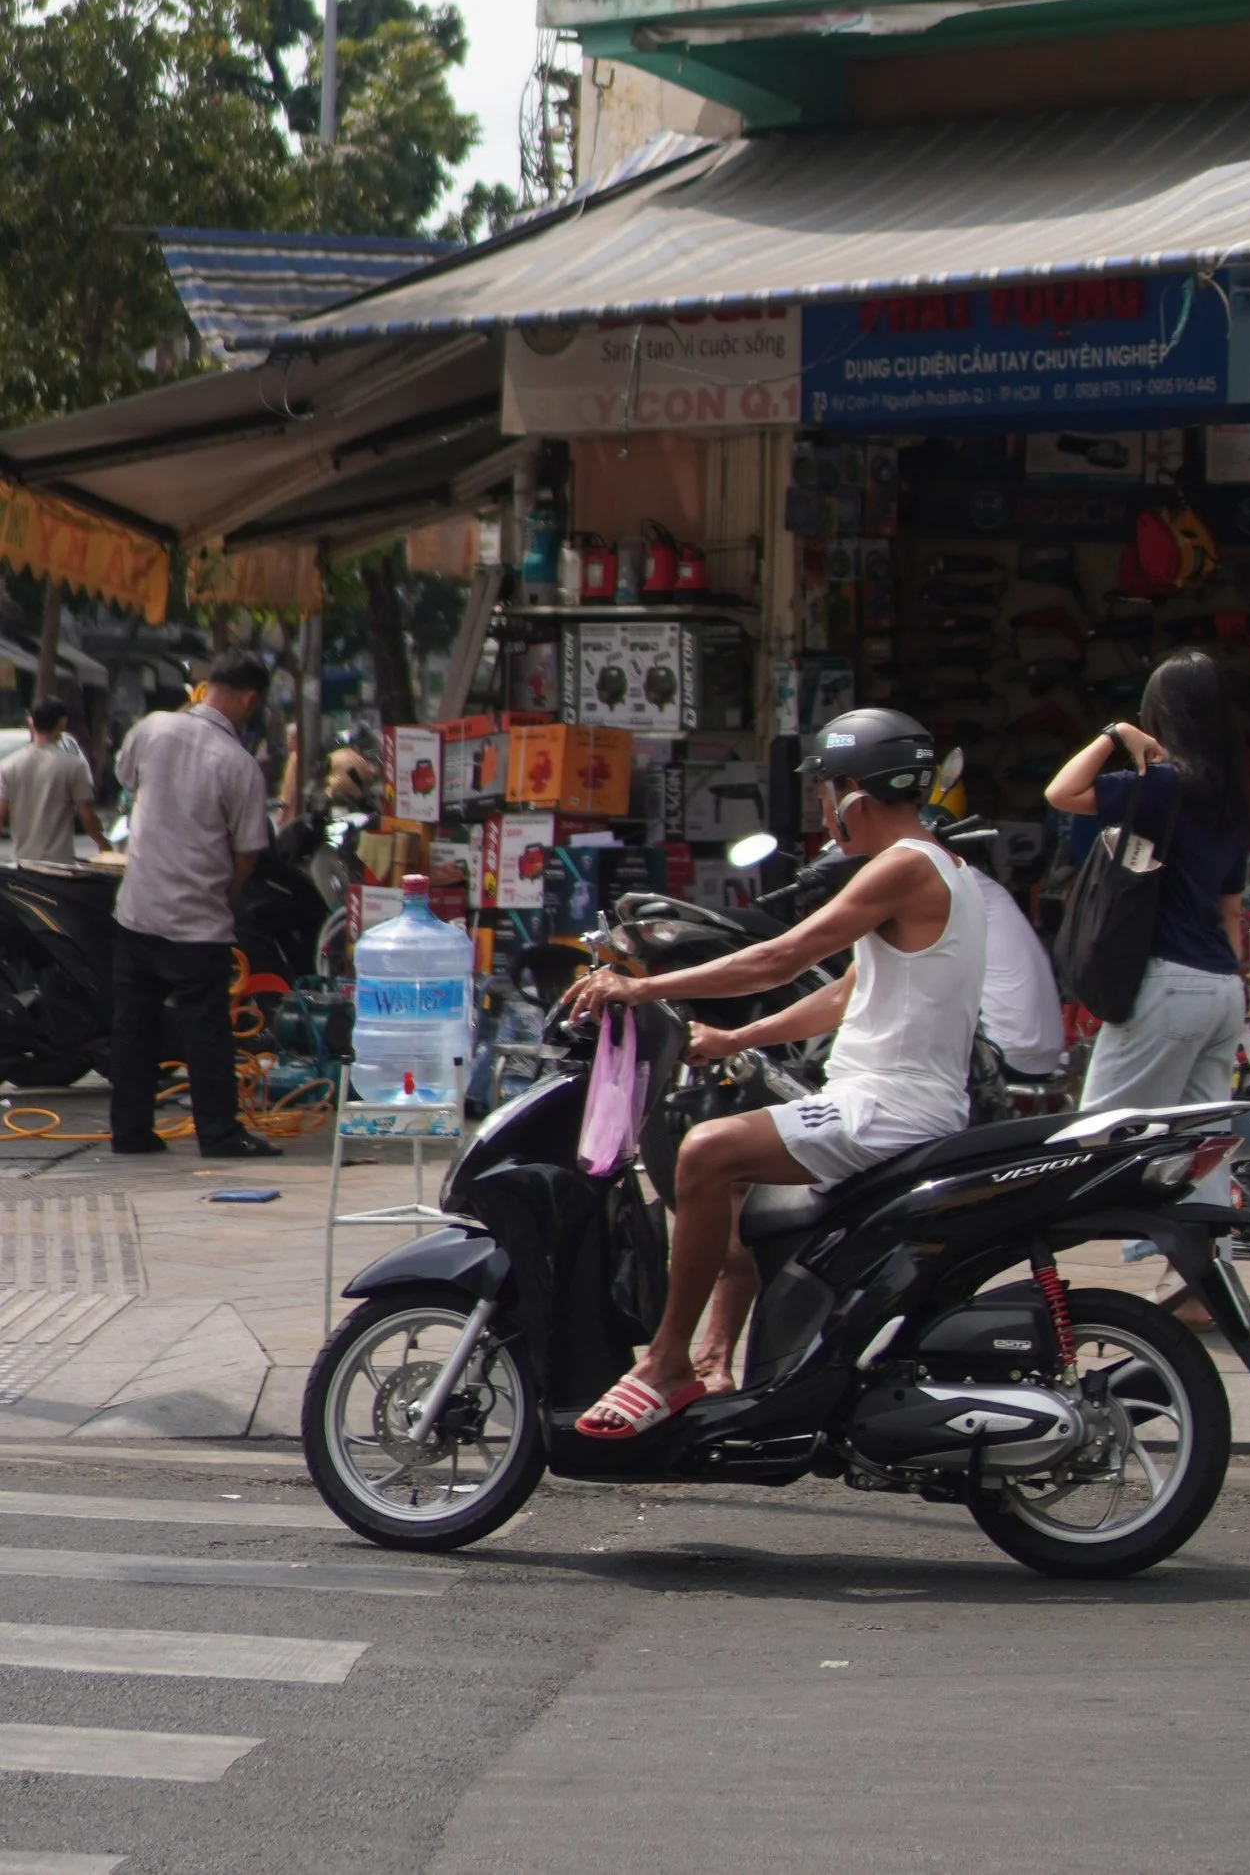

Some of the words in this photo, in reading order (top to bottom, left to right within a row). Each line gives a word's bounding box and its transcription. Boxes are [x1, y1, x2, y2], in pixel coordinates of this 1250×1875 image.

[845, 357, 891, 384] DỤNG
[894, 356, 917, 382] CỤ
[999, 350, 1029, 372] TAY
[1033, 342, 1103, 371] CHUYÊN
[1105, 338, 1168, 370] NGHIỆP
[636, 388, 726, 424] CON
[991, 1153, 1094, 1183] VISION
